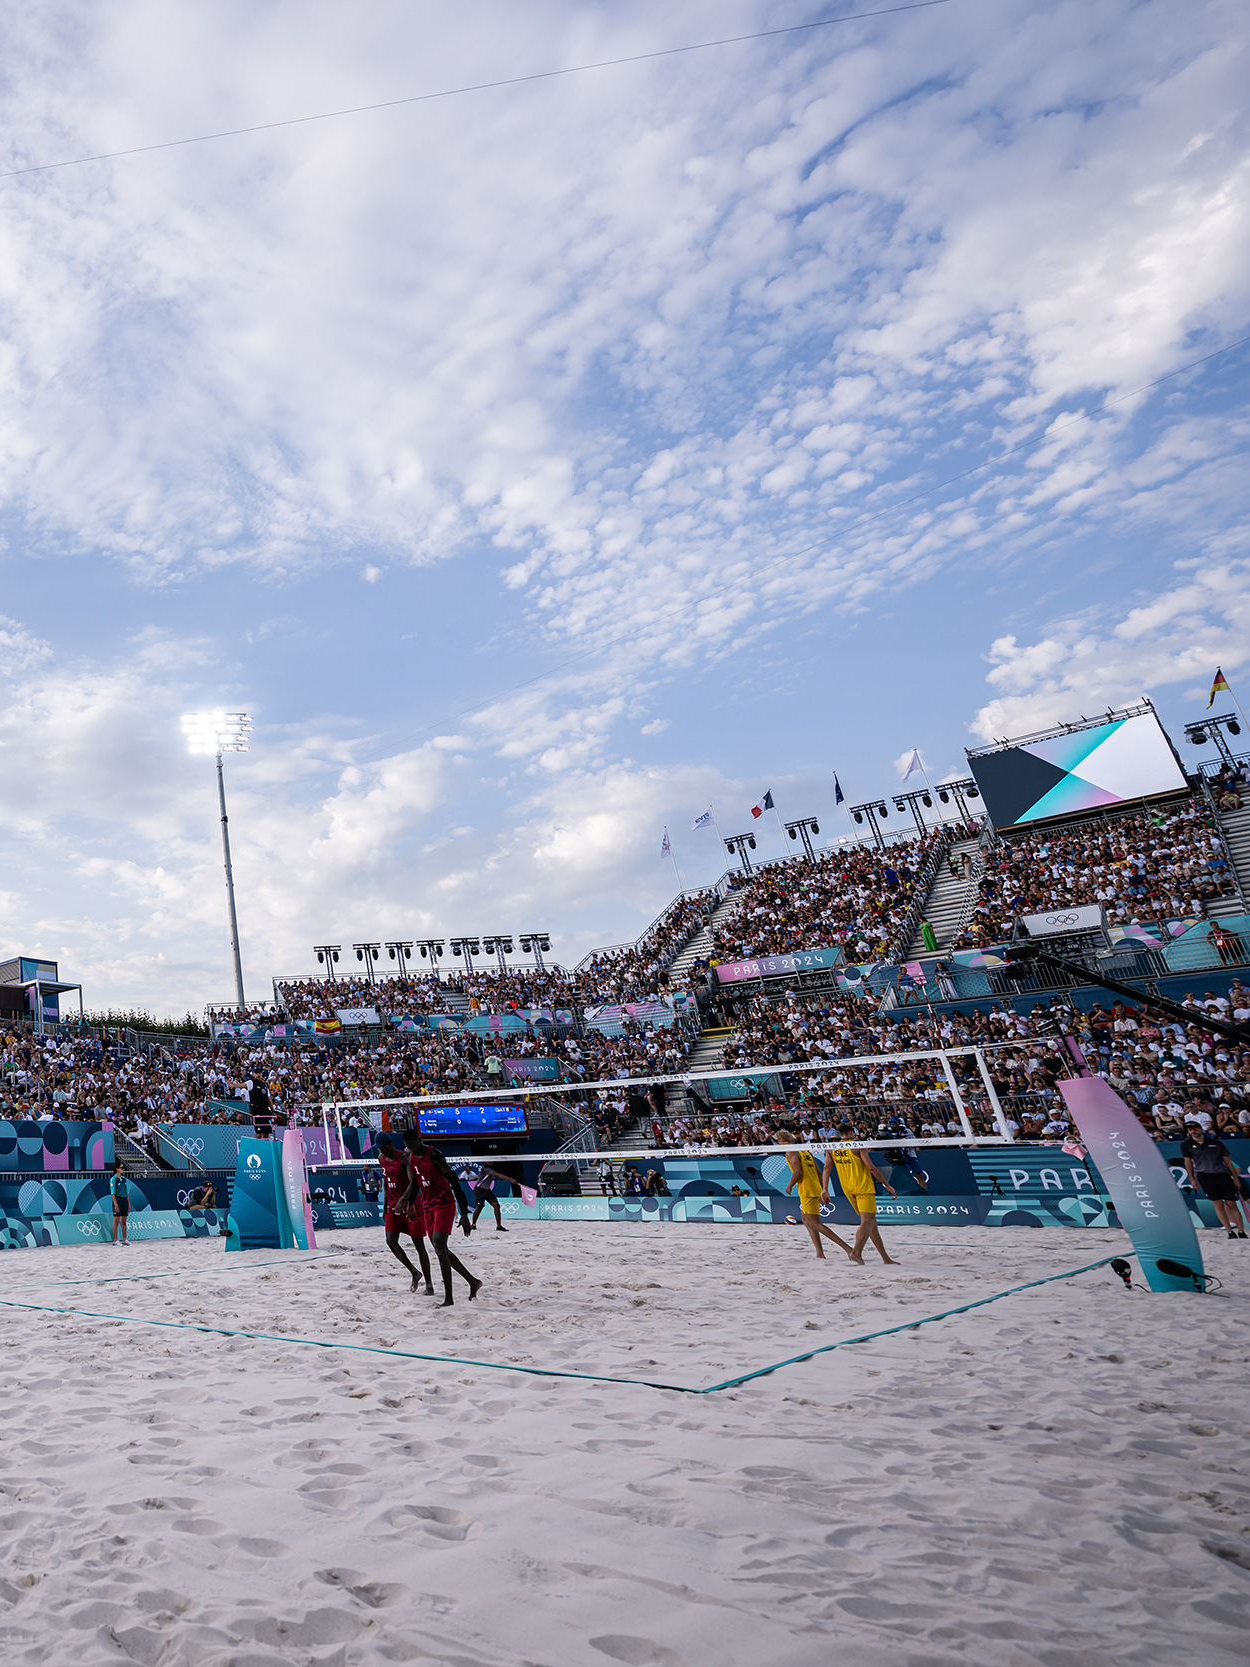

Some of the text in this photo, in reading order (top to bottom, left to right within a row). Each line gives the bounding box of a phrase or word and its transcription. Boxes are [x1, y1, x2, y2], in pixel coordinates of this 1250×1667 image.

[733, 955, 824, 976] PARIS 2024
[414, 1165, 420, 1175] 1
[1109, 1132, 1159, 1218] PARIS 2024
[544, 1204, 603, 1212] PARIS 2024
[876, 1205, 969, 1215] PARIS 2024
[126, 1219, 178, 1230] PARIS 2024
